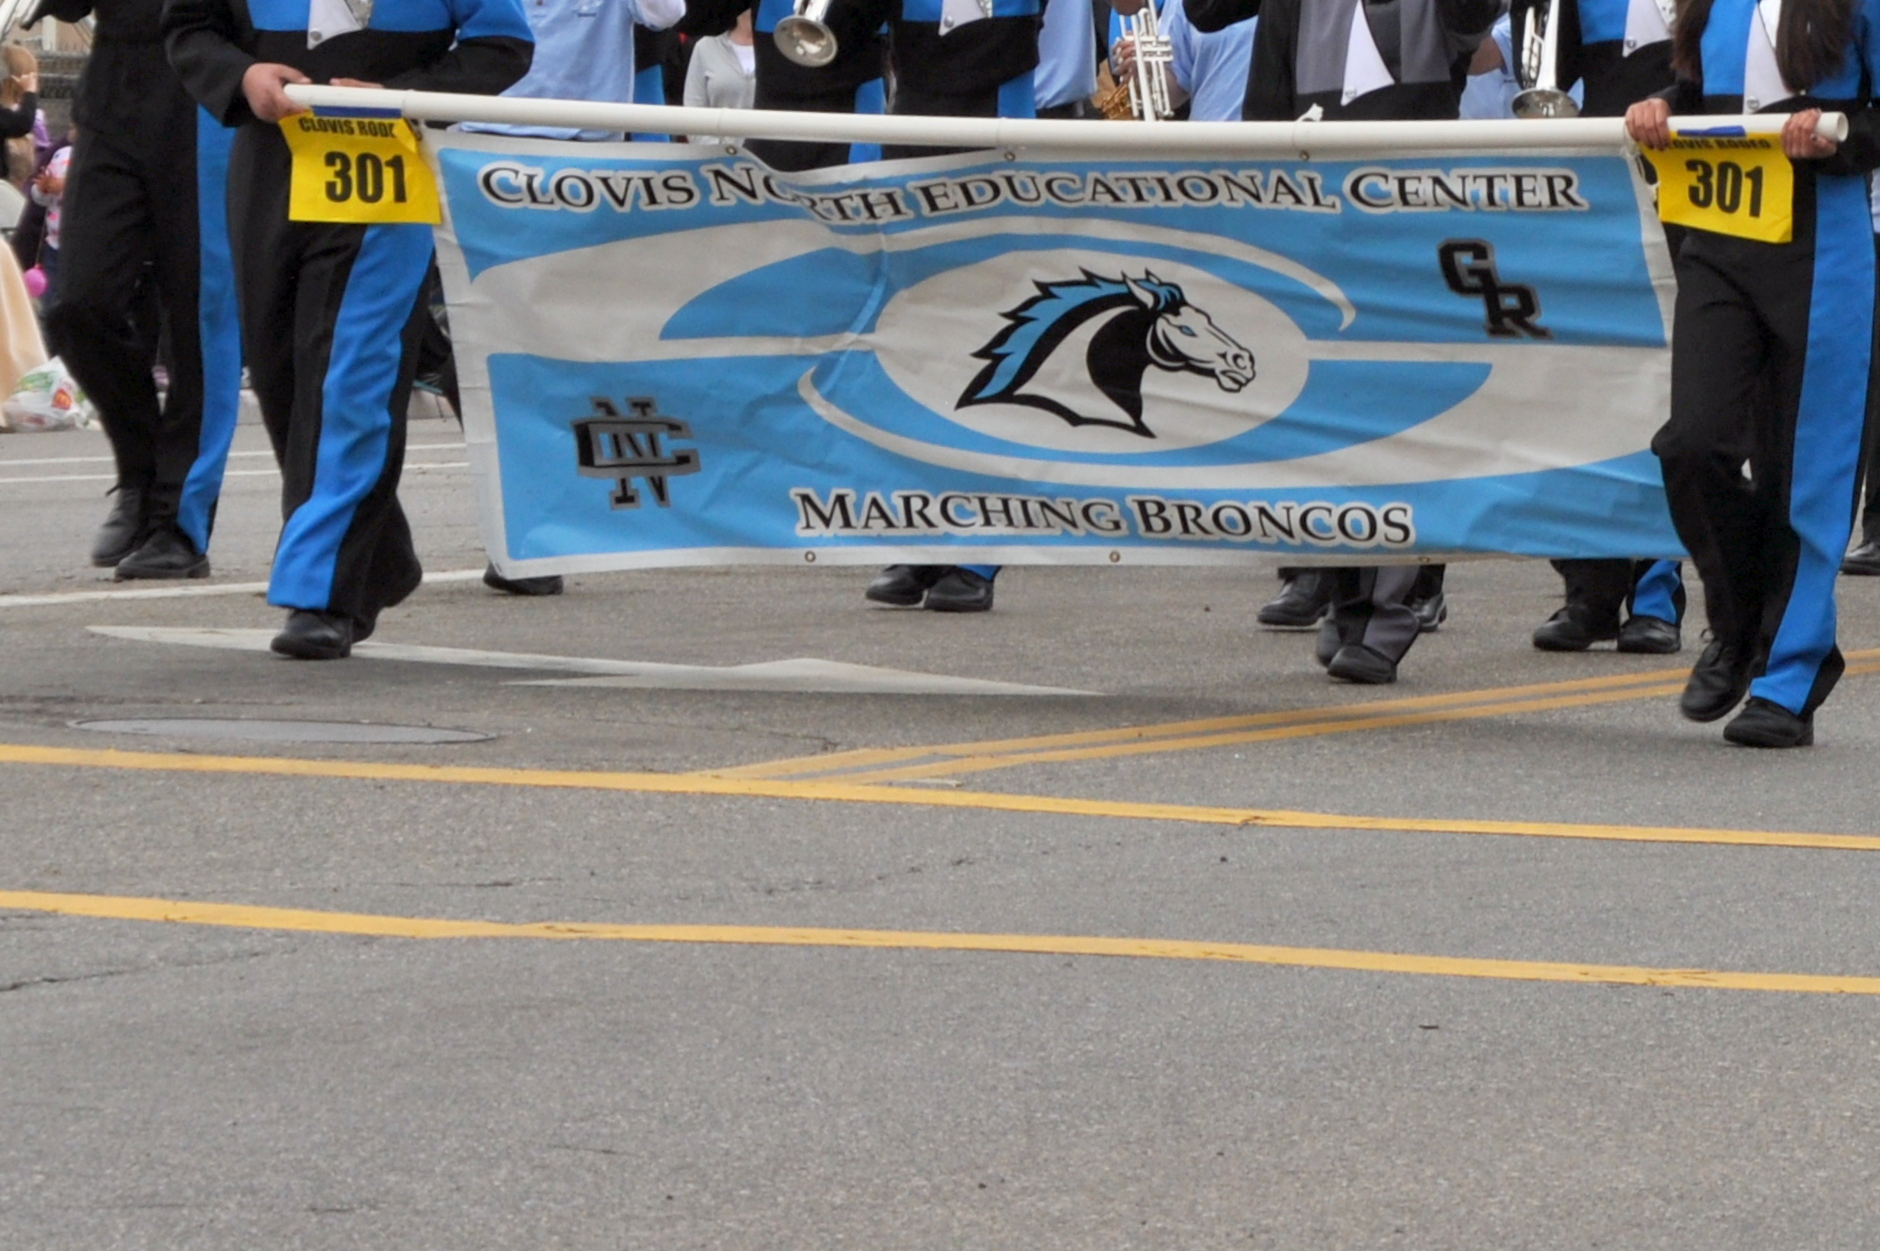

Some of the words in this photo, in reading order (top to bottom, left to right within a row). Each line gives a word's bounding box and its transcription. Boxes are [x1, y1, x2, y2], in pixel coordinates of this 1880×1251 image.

[298, 116, 355, 136] CLOVIS
[324, 150, 408, 204] 301
[481, 166, 695, 208] CLOVIS
[914, 174, 1338, 214] EDUCATIONAL
[1350, 171, 1585, 209] CENTER
[1685, 158, 1763, 218] 301
[795, 492, 1123, 532] MARCHING
[1131, 498, 1411, 544] BRONCOS
